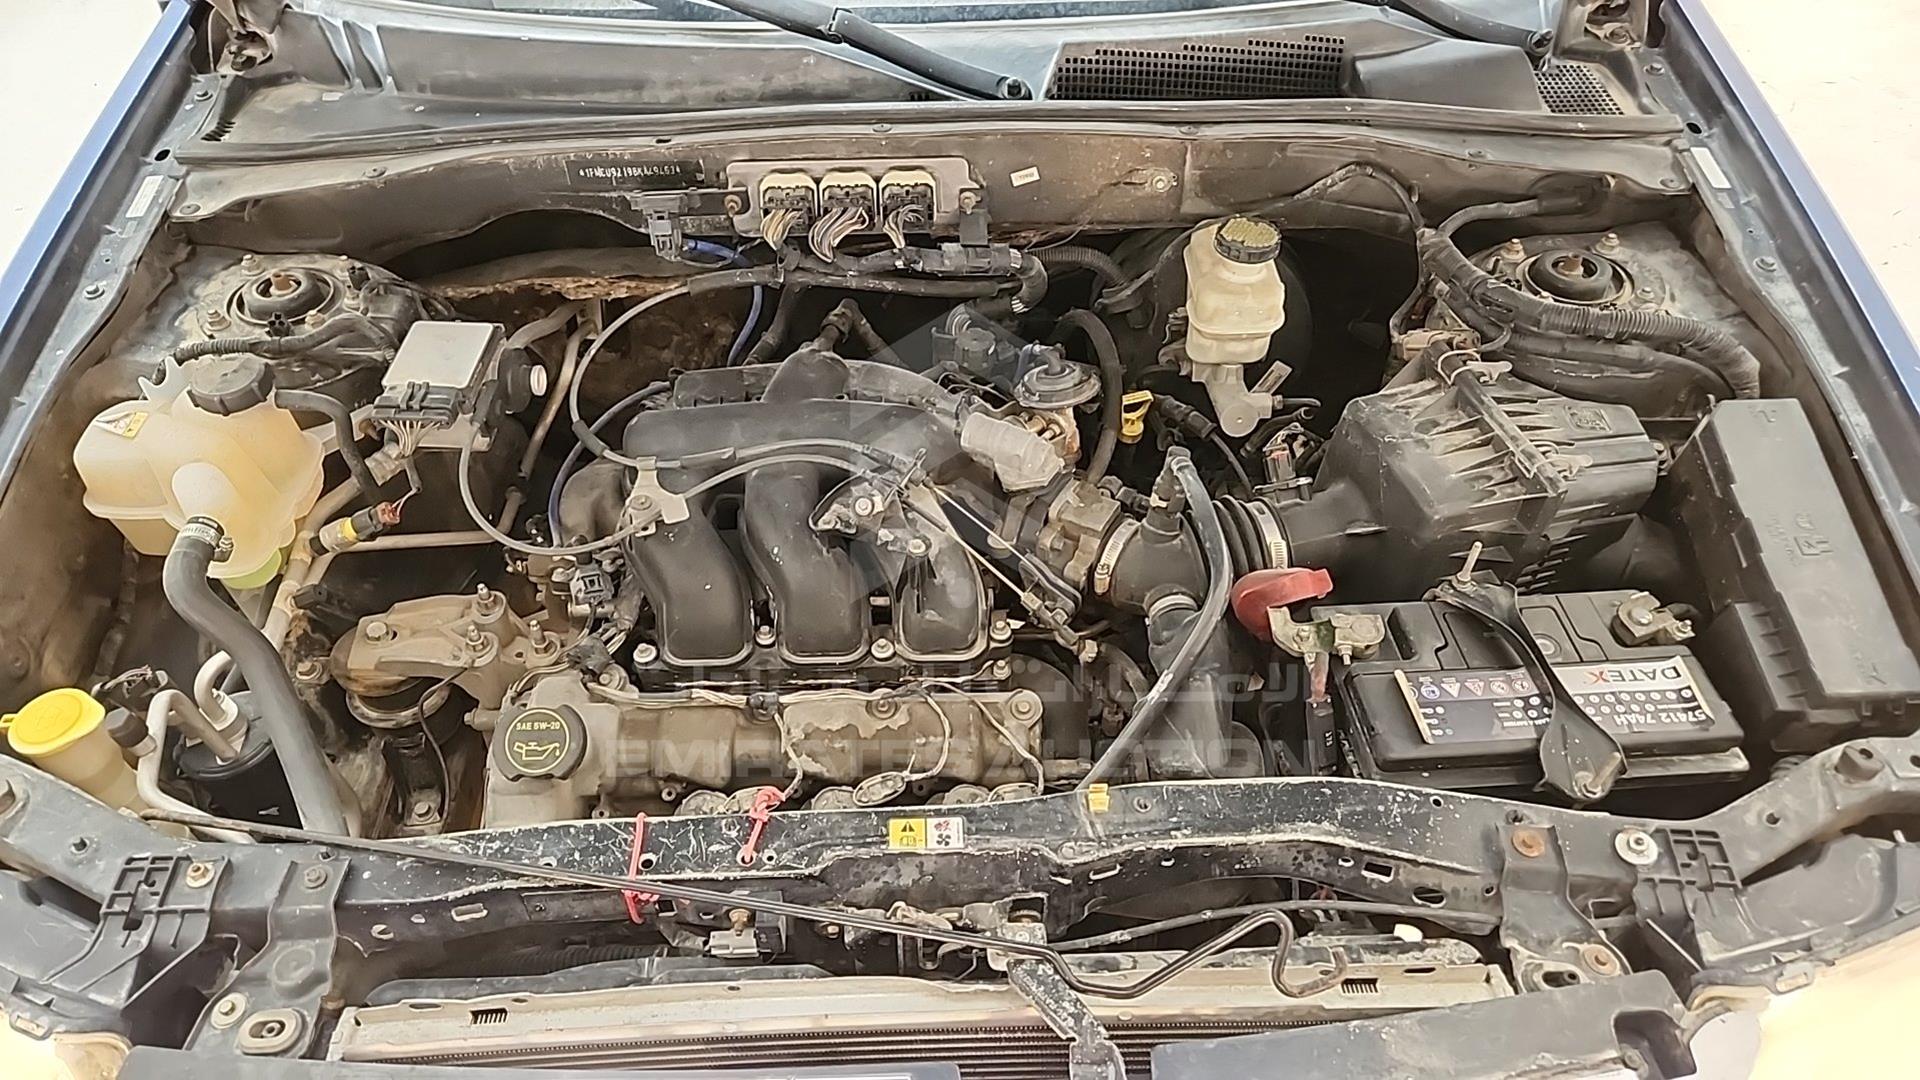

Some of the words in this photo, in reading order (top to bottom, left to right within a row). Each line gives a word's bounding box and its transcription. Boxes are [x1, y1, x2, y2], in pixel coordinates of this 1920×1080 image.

[1583, 665, 1681, 685] DATEX
[1613, 712, 1656, 725] 74AH
[1658, 709, 1707, 723] 57412
[516, 722, 532, 731] SAE
[533, 721, 561, 730] 5W-20
